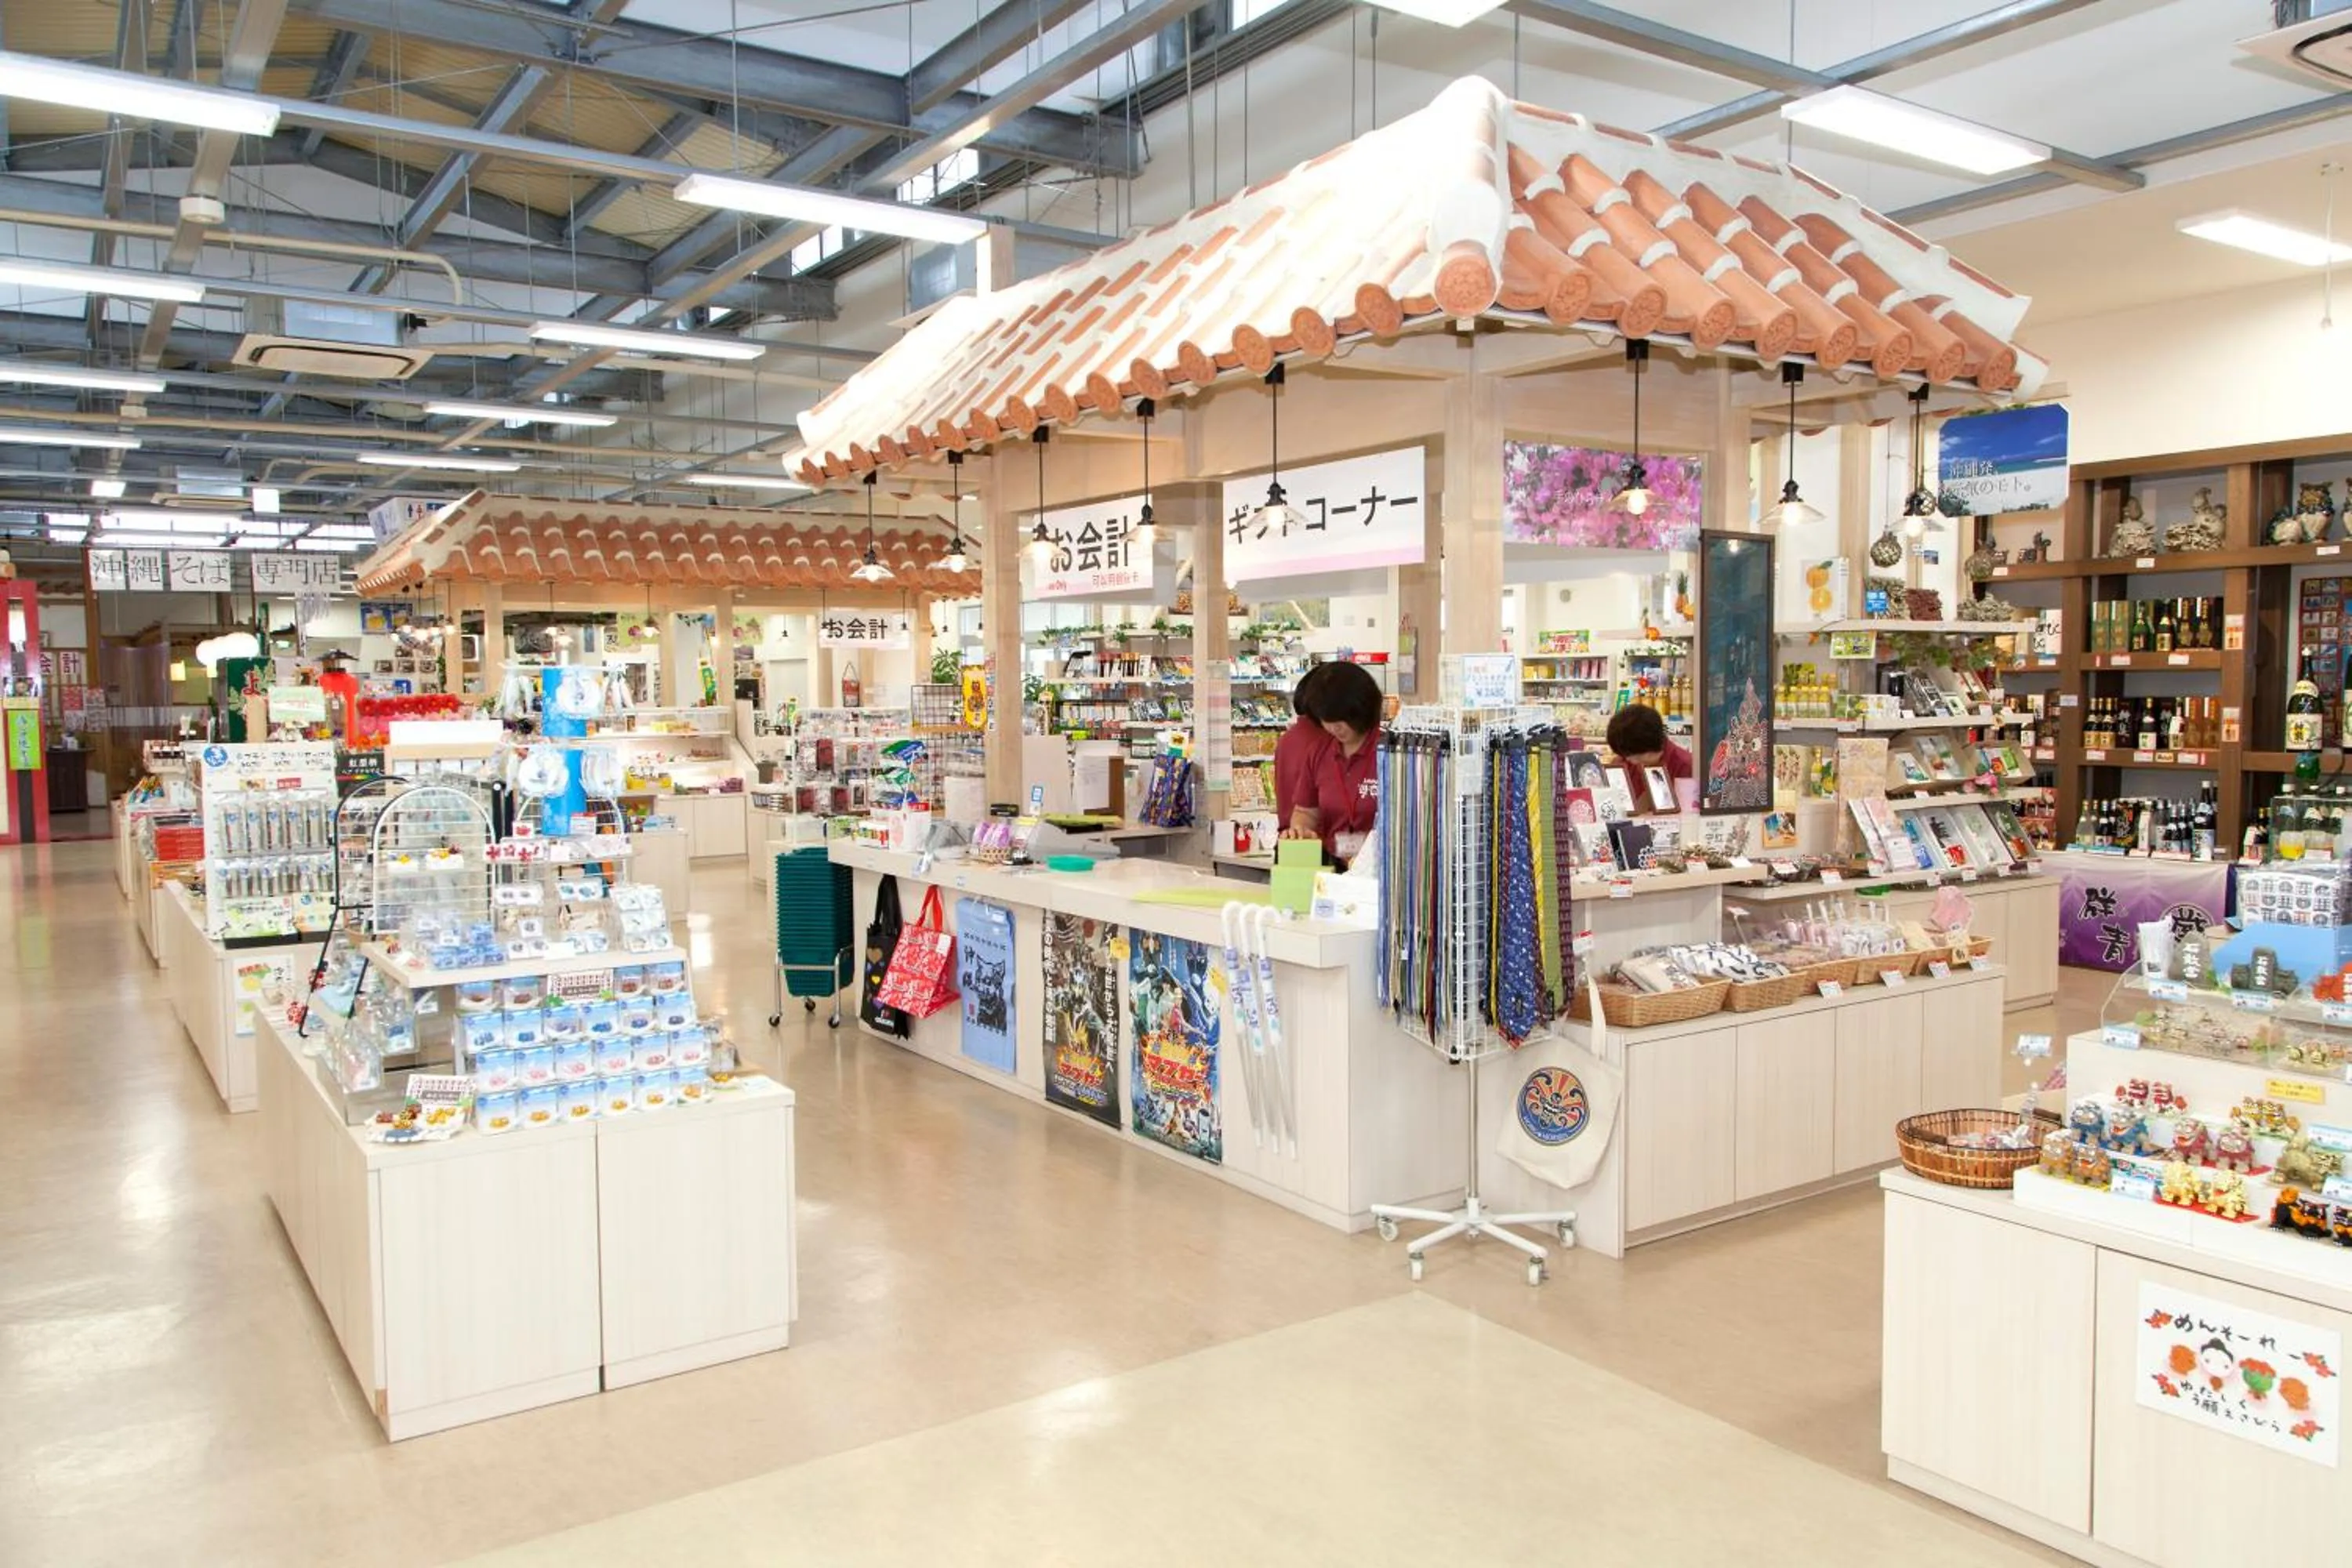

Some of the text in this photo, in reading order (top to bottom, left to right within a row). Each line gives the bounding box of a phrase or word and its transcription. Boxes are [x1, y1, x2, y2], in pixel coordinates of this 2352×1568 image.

[1049, 515, 1134, 573] お会計
[826, 618, 888, 640] お会計
[2174, 1313, 2302, 1360] めんそーれー
